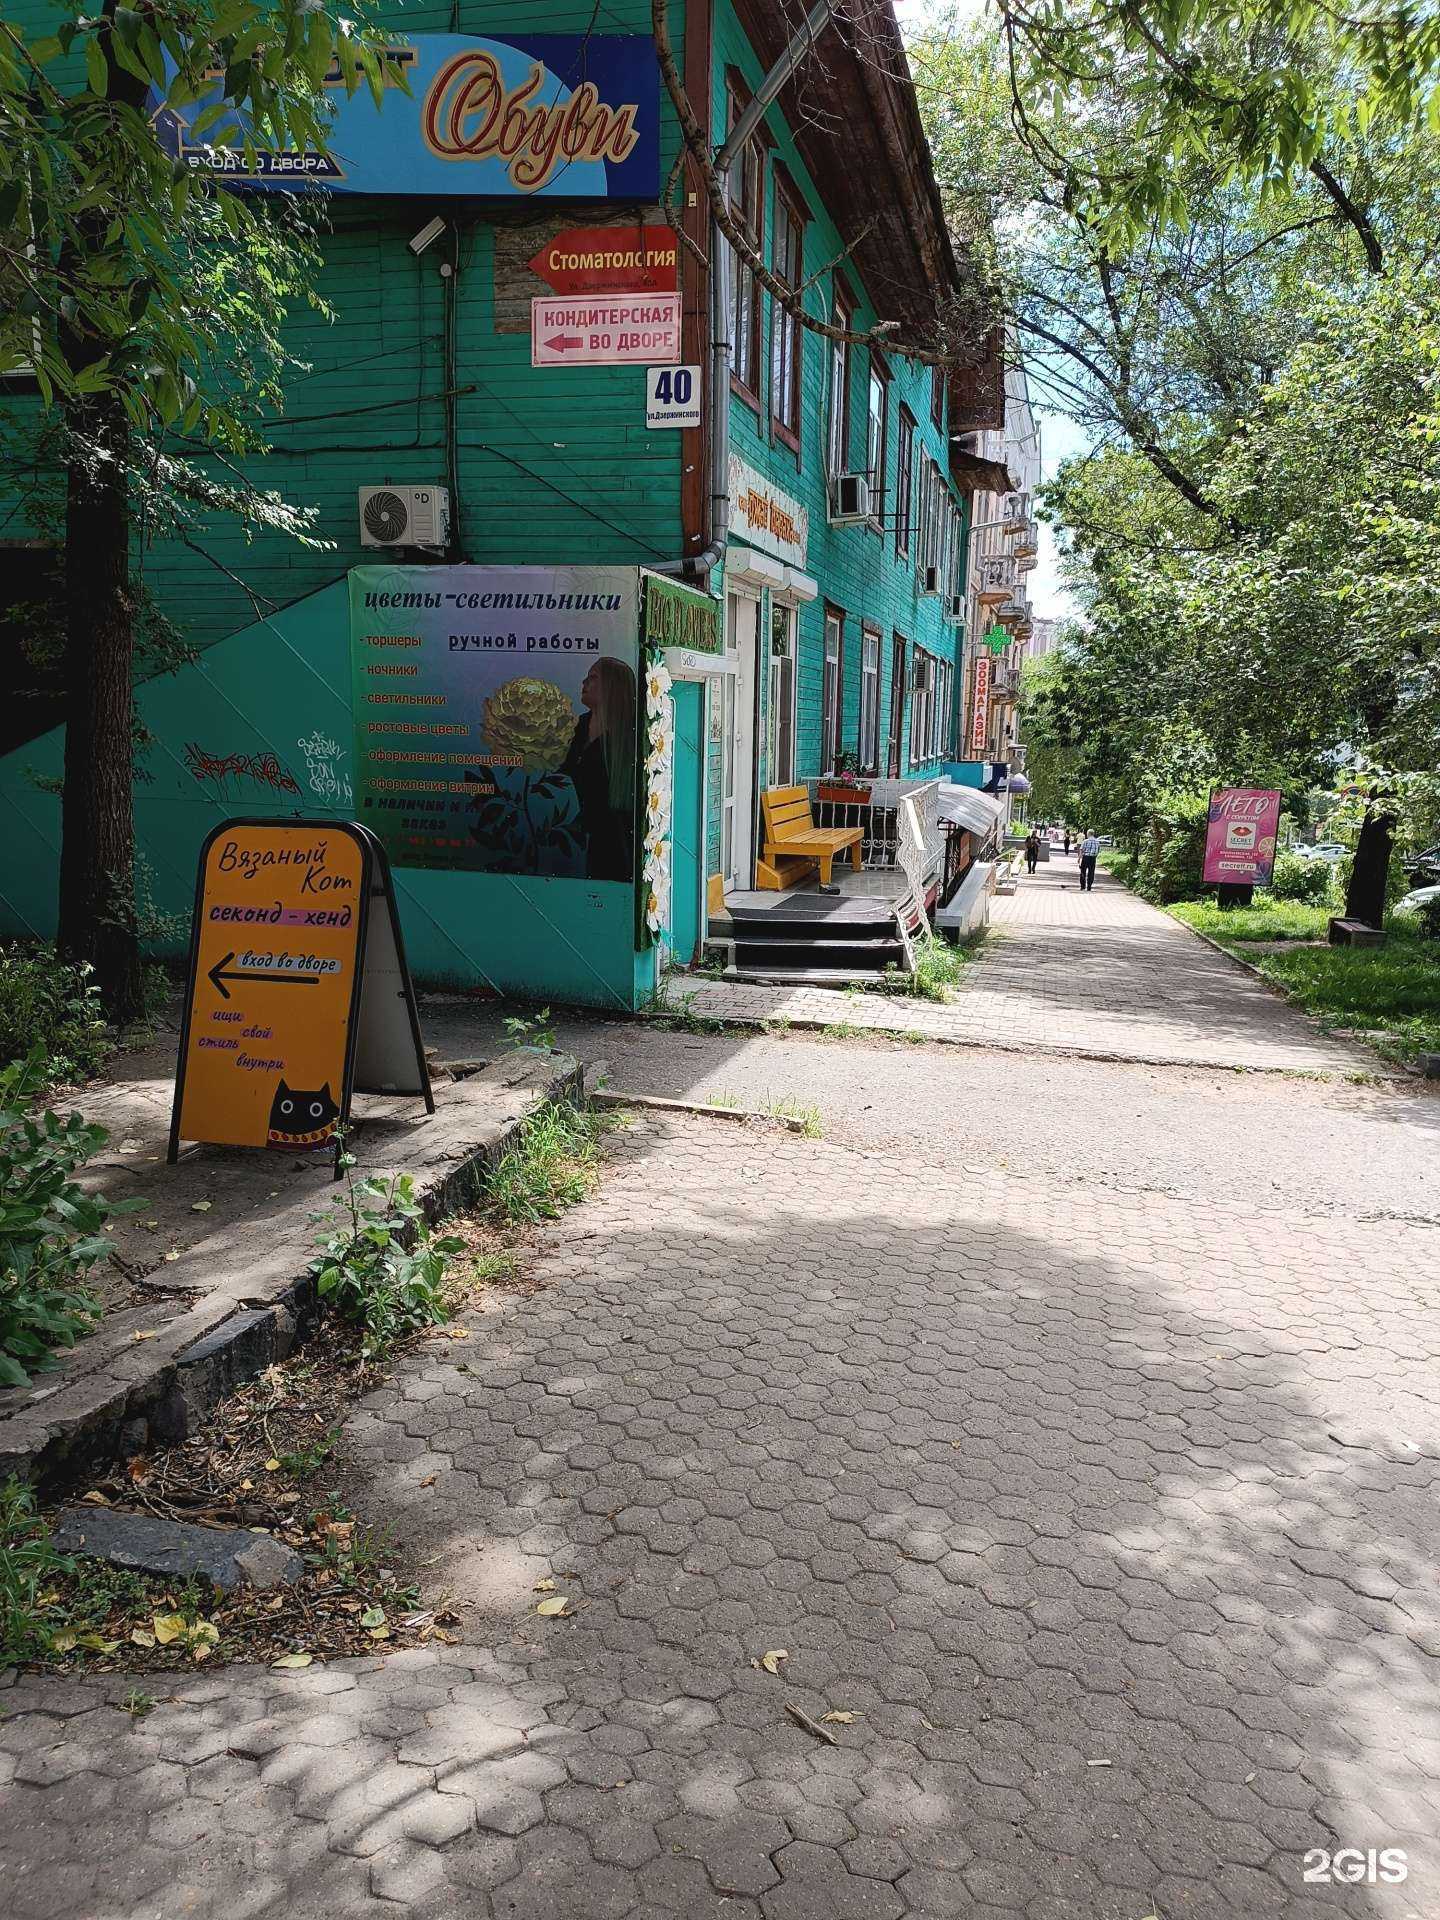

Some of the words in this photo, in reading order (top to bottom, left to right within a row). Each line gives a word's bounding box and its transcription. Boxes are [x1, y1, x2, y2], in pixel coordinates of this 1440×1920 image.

[188, 156, 236, 171] ВХОД
[271, 157, 329, 171] ДВОРА
[549, 250, 676, 271] Стоматология
[544, 306, 674, 329] КОНДИТЕРСКАЯ
[589, 333, 611, 350] ВО
[617, 332, 673, 351] ДВОРЕ
[654, 369, 692, 405] 40
[366, 635, 422, 647] торшеры
[449, 632, 518, 651] ручной
[525, 634, 600, 652] работы
[367, 664, 418, 676] ночники
[367, 693, 447, 706] светильники
[974, 661, 988, 747] ЗООМАГАЗИН
[368, 722, 428, 736] ростовые
[430, 724, 470, 736] цветы
[368, 750, 446, 763] оформление
[448, 752, 524, 767] помещений
[369, 777, 447, 793] оформление
[448, 781, 496, 796] витрин
[1217, 795, 1270, 816] ЛЕТО
[218, 840, 328, 879] Вязаный
[301, 866, 352, 893] Кот
[209, 901, 283, 924] секонд
[304, 904, 352, 926] хенд
[241, 950, 273, 967] вход
[278, 952, 293, 968] во
[297, 954, 336, 975] дворе
[212, 1011, 243, 1023] ищи
[242, 1025, 272, 1038] свой
[198, 1037, 240, 1049] стиль
[236, 1052, 284, 1072] внутри
